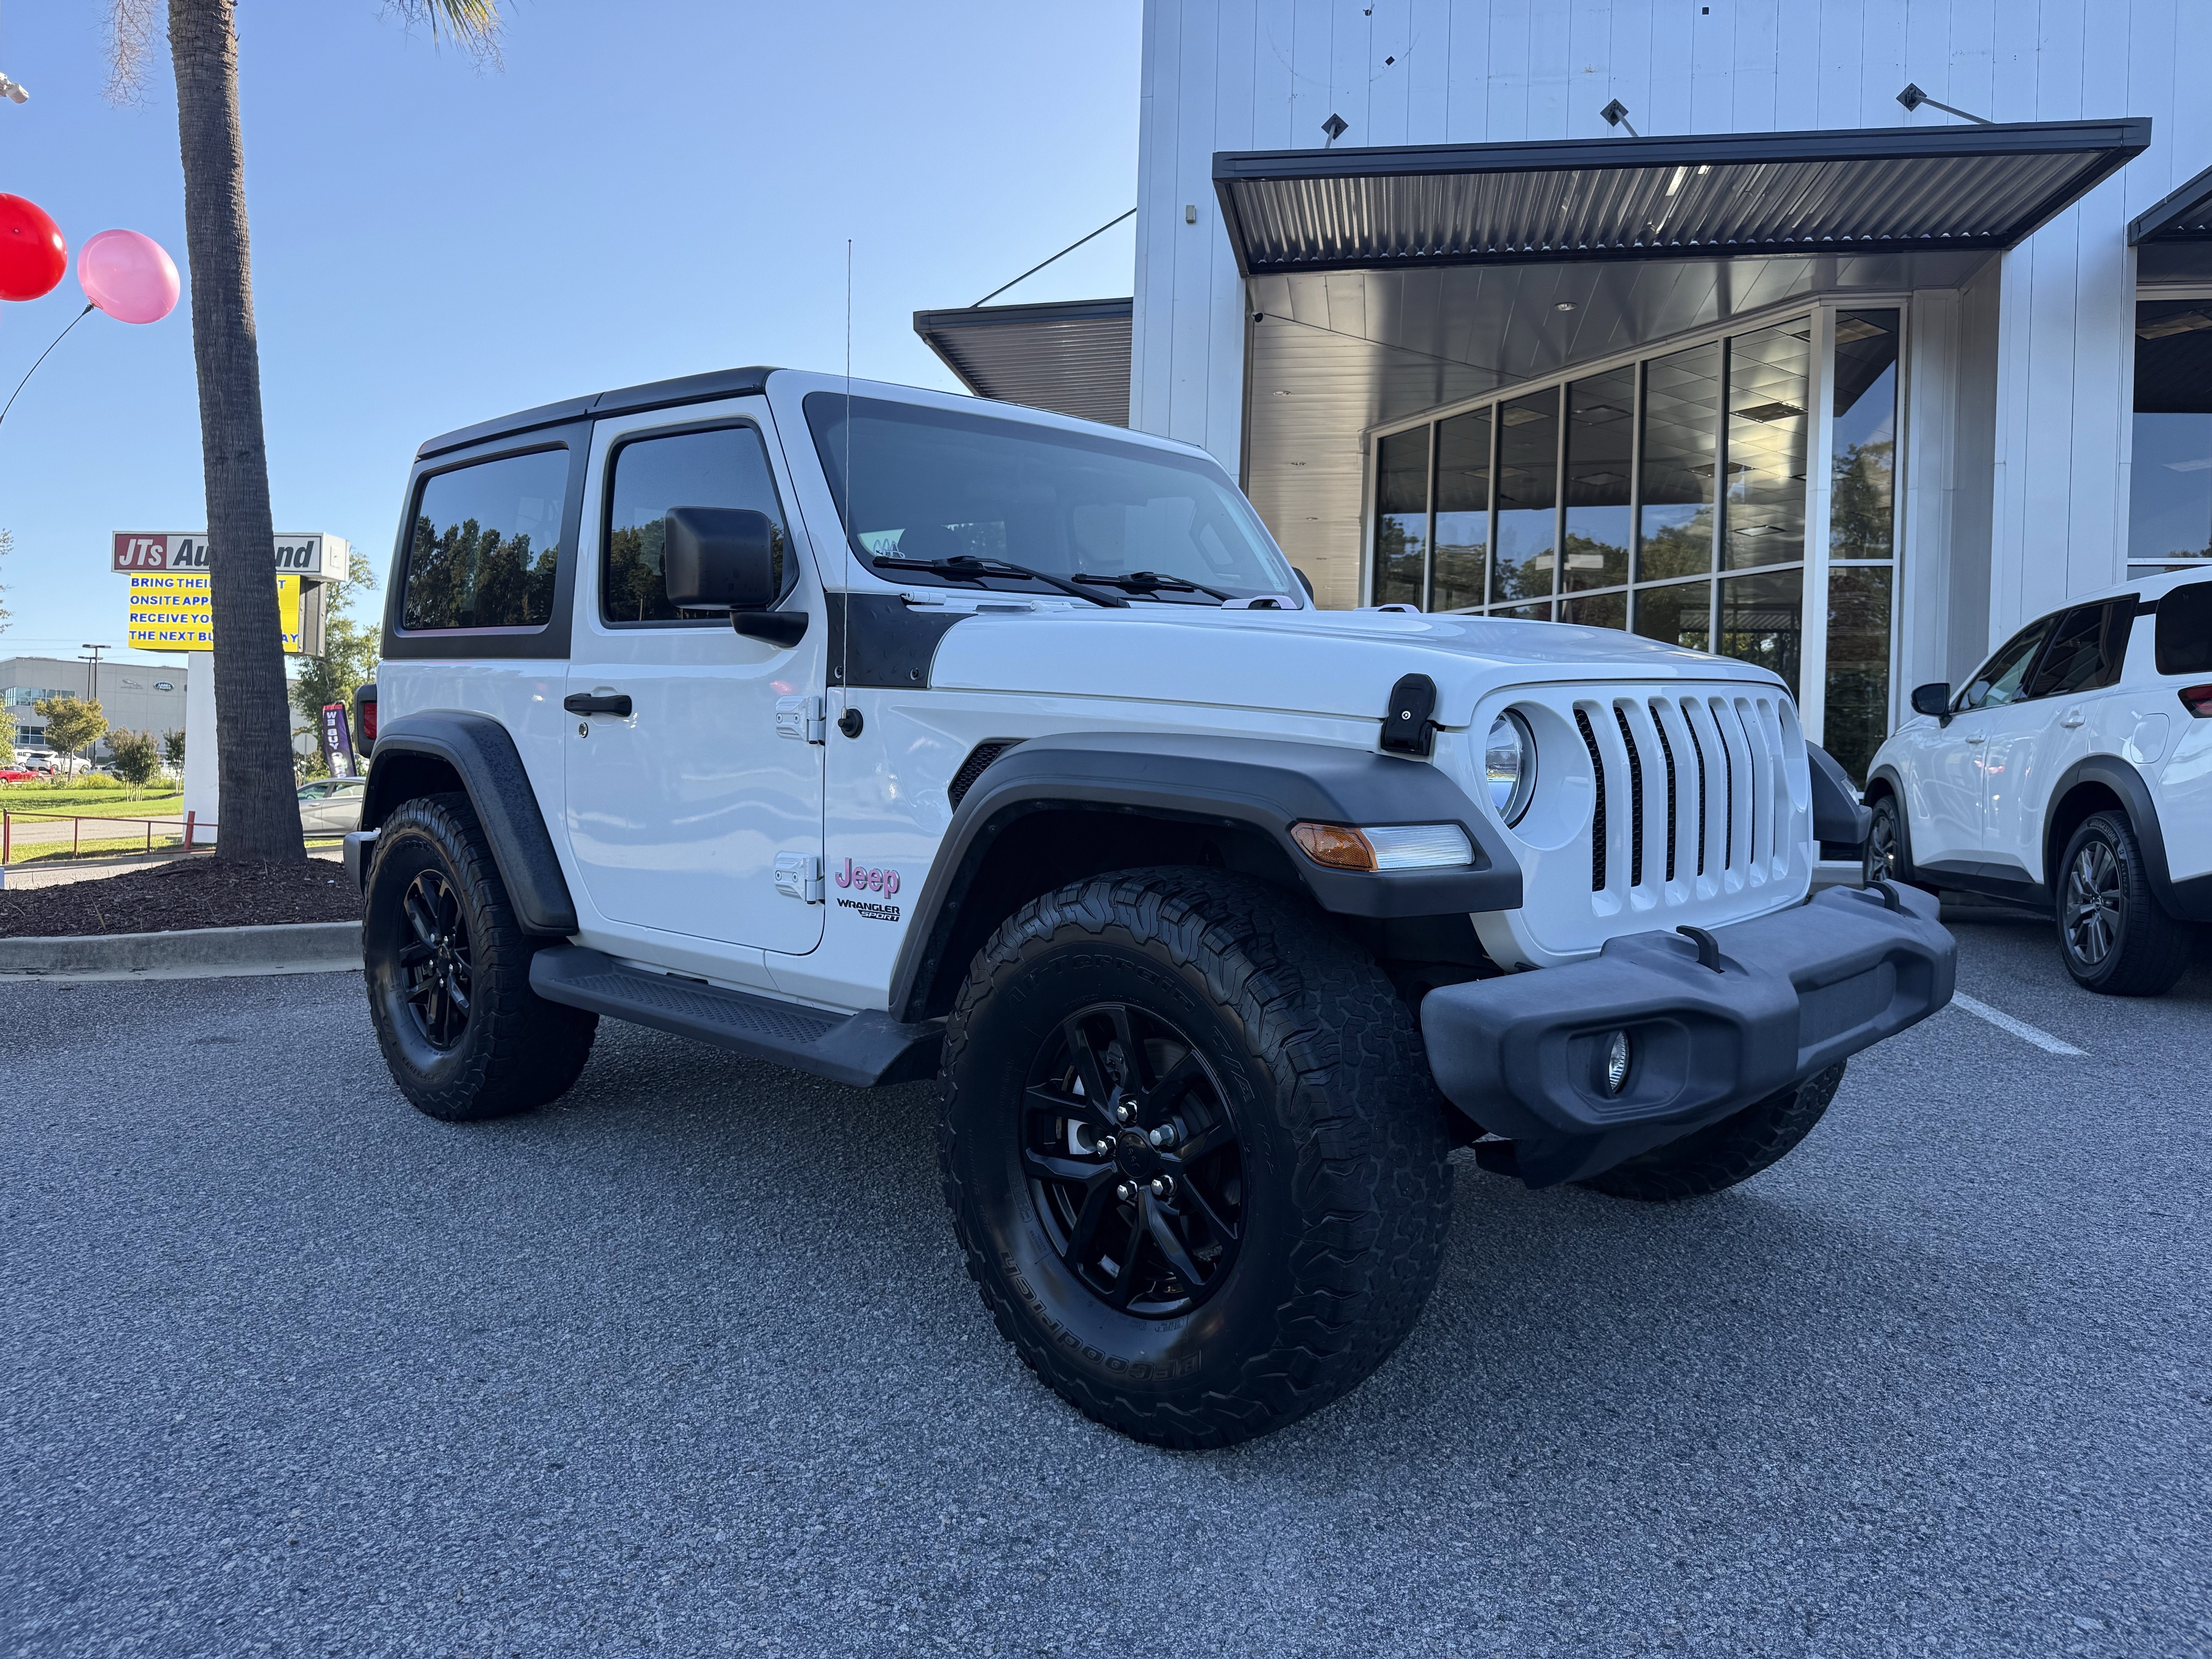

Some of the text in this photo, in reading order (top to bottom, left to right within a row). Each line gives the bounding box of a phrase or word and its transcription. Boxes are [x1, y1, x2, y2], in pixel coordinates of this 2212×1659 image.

[119, 539, 163, 566] JTs
[131, 578, 211, 588] BRING THEI
[130, 595, 180, 605] ONSITE
[130, 613, 188, 623] RECEIVE
[129, 630, 155, 640] THE
[159, 631, 195, 641] NEXT
[326, 711, 337, 726] WE
[327, 728, 340, 750] BUY
[835, 857, 901, 900] Jeep
[836, 898, 901, 915] WRANGLER
[860, 910, 900, 921] SPORT
